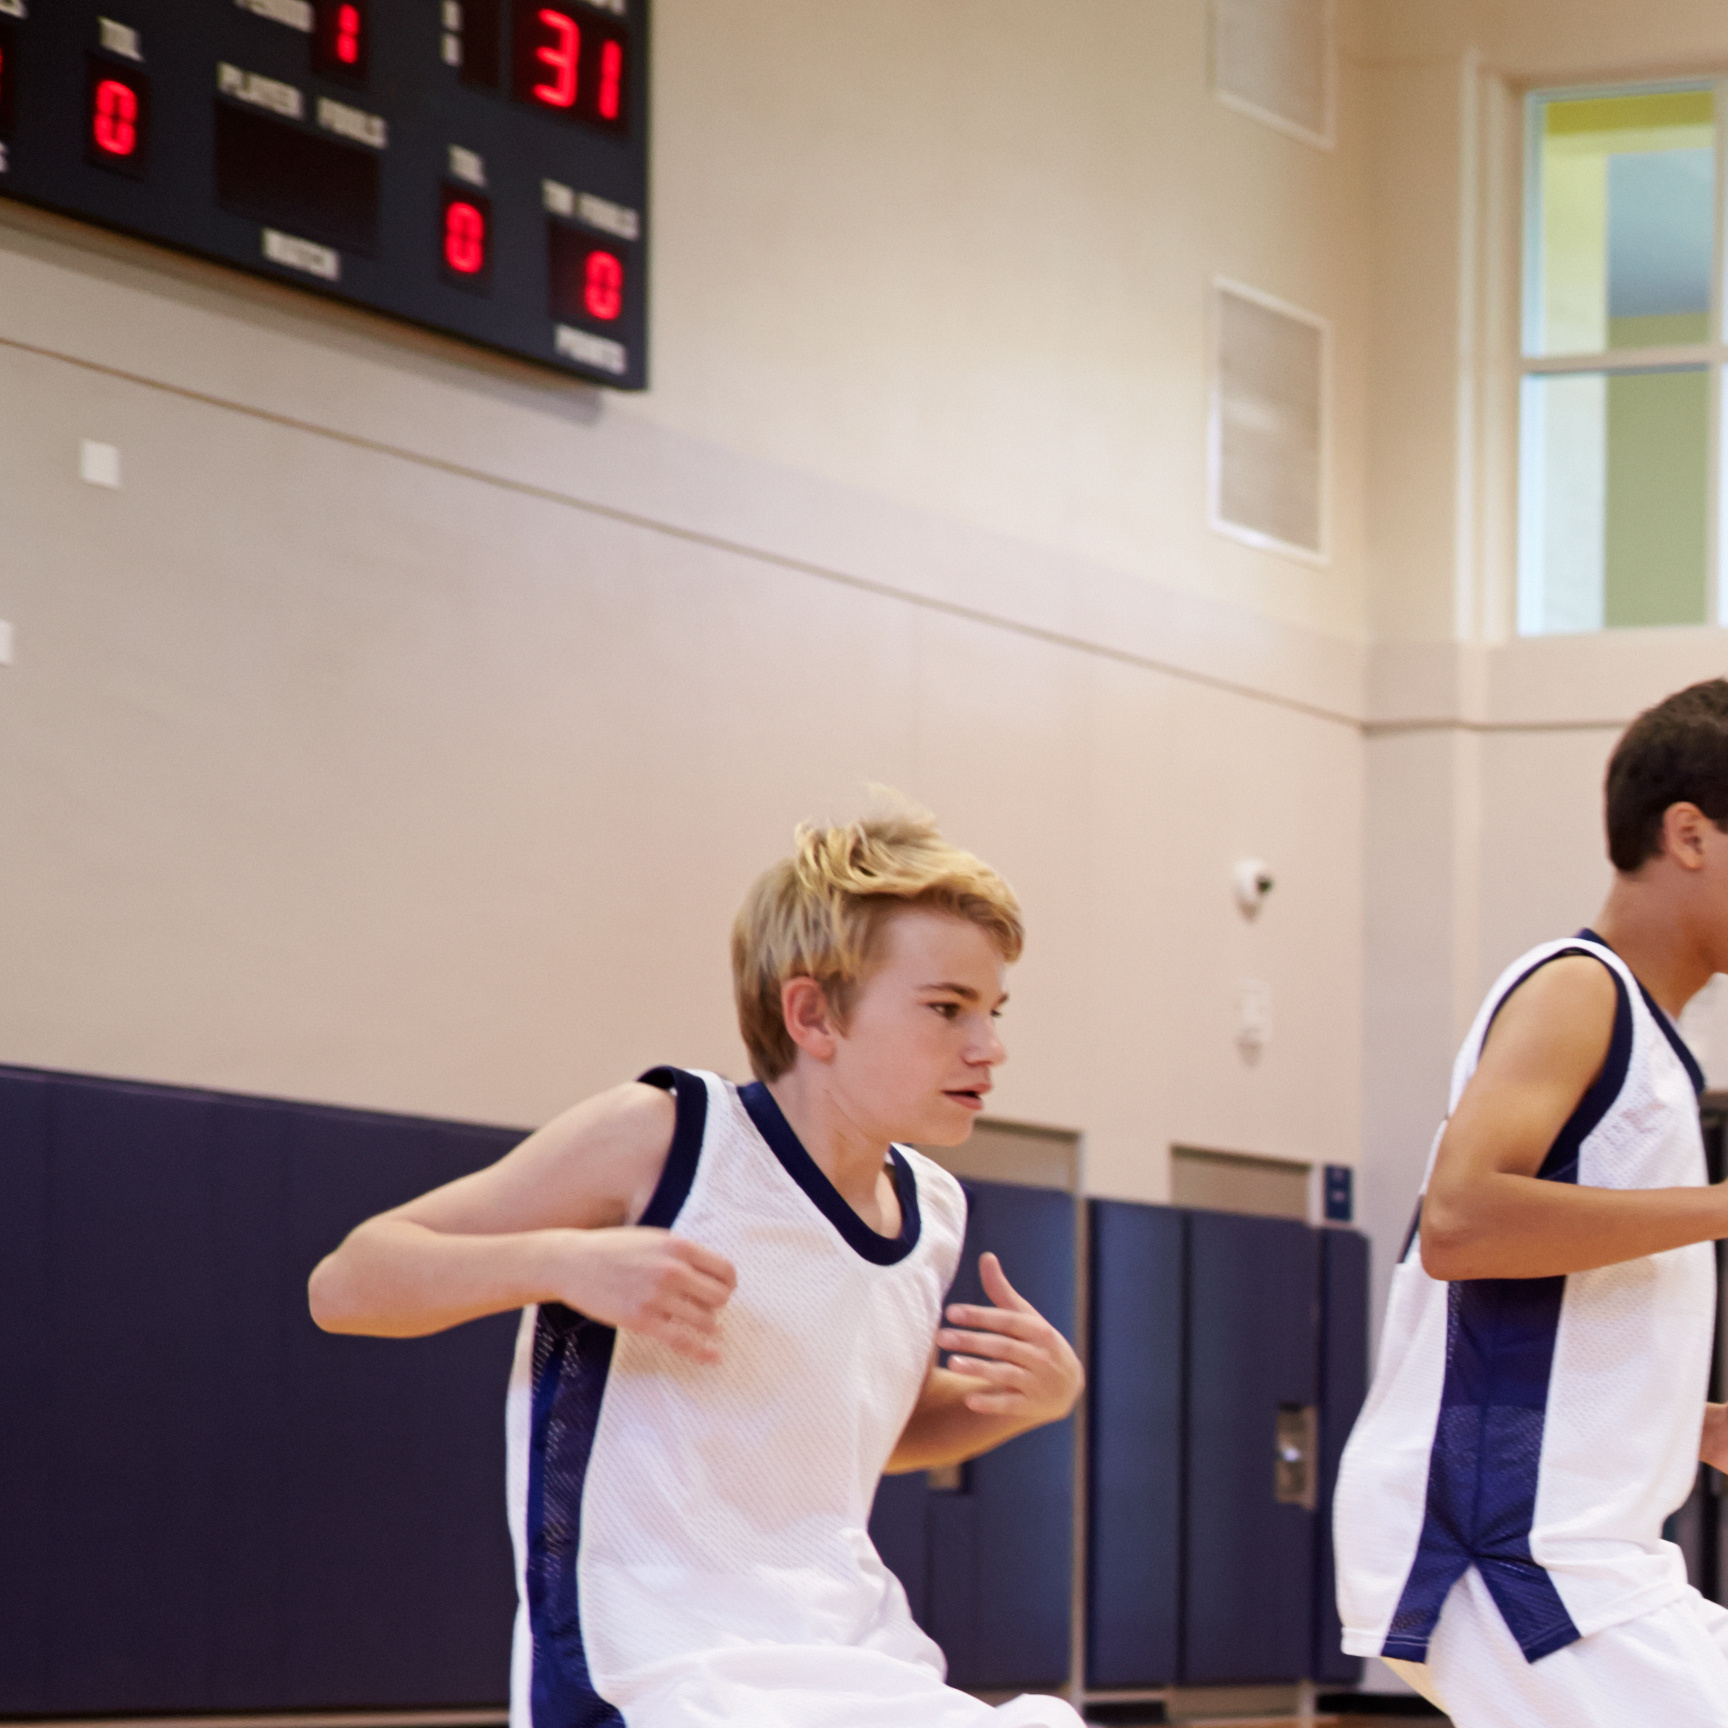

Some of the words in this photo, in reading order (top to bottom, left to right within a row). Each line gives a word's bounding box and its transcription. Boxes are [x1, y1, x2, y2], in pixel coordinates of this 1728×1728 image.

[338, 3, 359, 64] 1
[533, 8, 622, 120] 31
[94, 79, 138, 156] 0
[446, 201, 484, 274] 0
[585, 251, 623, 320] 0
